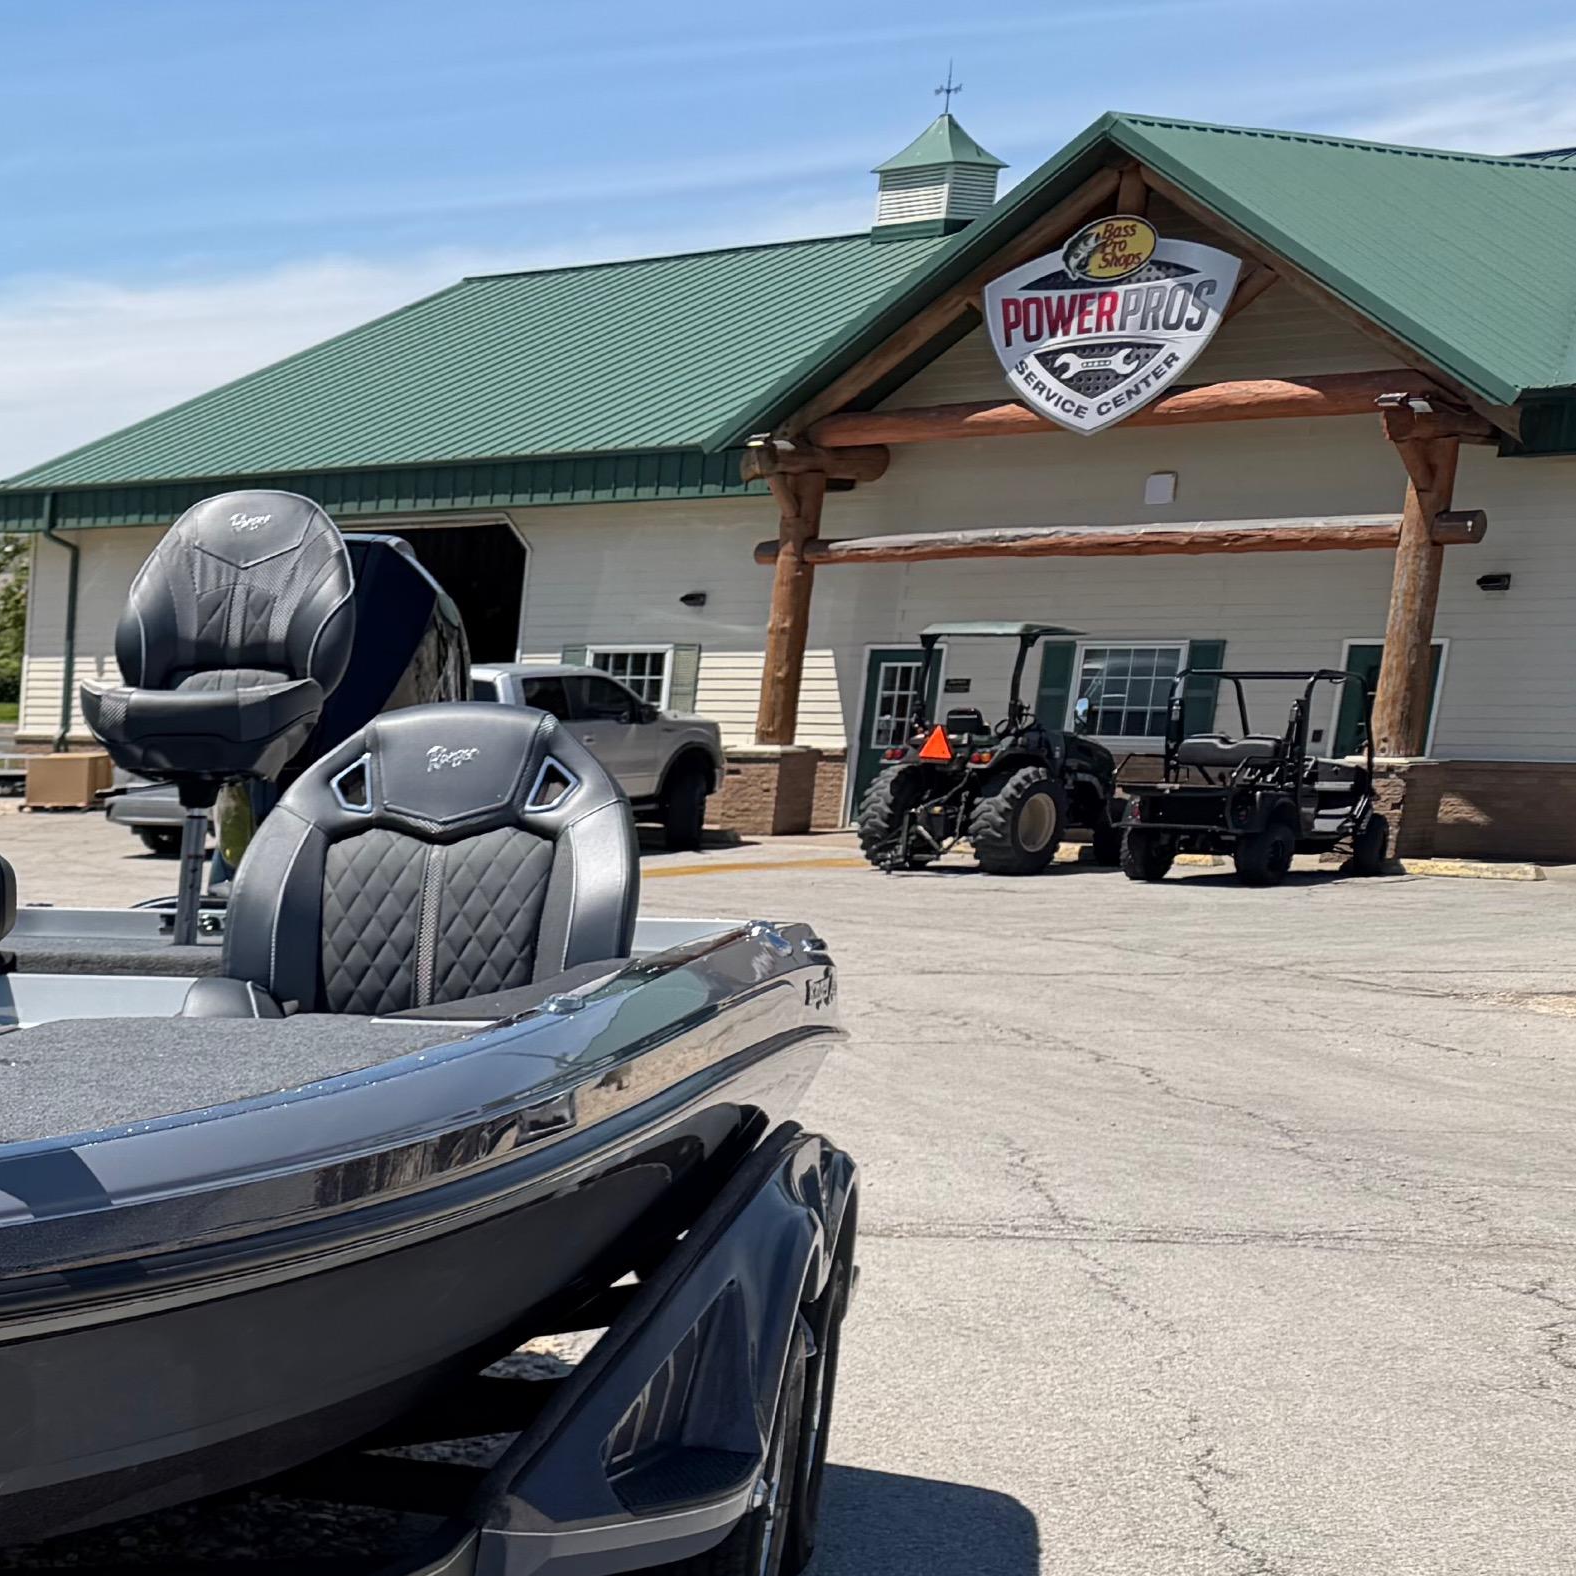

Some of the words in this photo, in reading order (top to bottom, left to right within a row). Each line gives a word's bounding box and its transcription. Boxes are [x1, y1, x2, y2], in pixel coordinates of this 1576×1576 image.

[1102, 222, 1137, 239] Bass
[1100, 239, 1128, 254] Pro
[1098, 252, 1143, 270] Shops
[1015, 359, 1089, 420] SERVICE
[1096, 350, 1180, 417] CENTER
